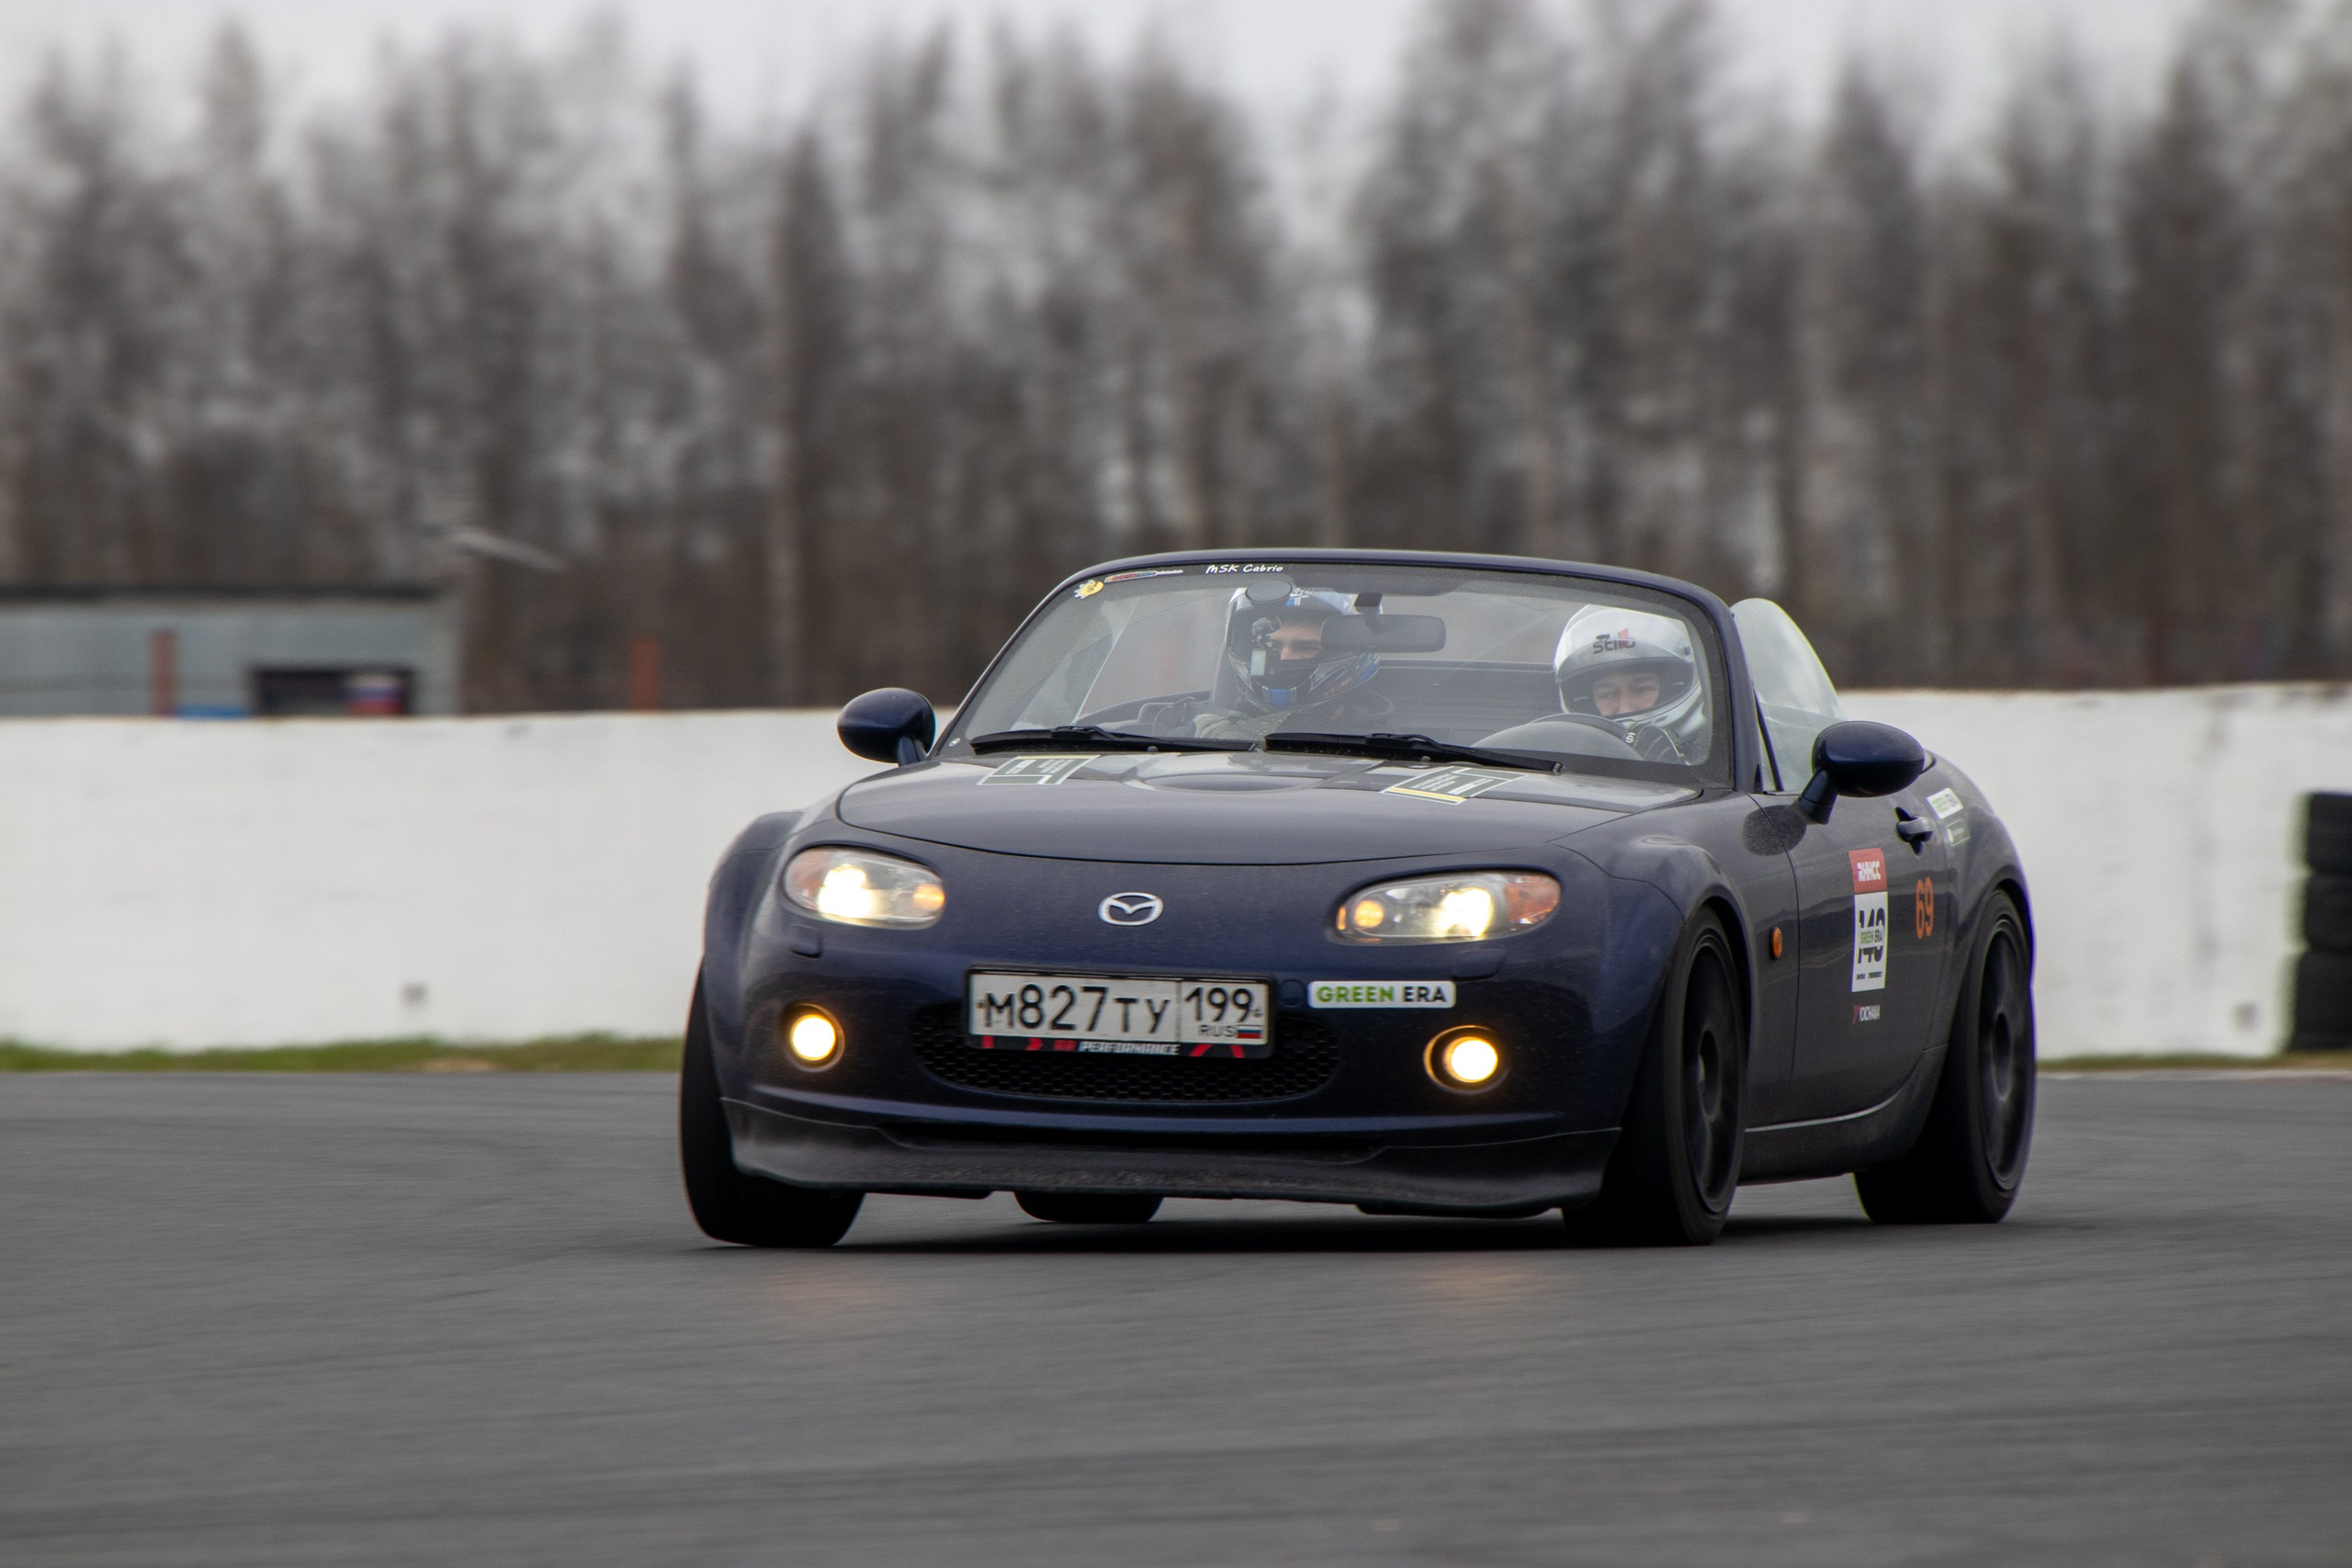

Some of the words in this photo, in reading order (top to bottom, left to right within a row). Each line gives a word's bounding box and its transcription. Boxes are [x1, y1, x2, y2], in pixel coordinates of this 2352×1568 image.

[1243, 563, 1283, 573] Cabrio
[1917, 876, 1934, 940] 69
[1875, 930, 1883, 942] ERA
[1317, 986, 1395, 1003] GREEN
[1403, 986, 1447, 1003] ERA
[1185, 986, 1254, 1024] 199
[1199, 1024, 1237, 1039] RUS
[1079, 1040, 1180, 1056] PERFORMANCE
